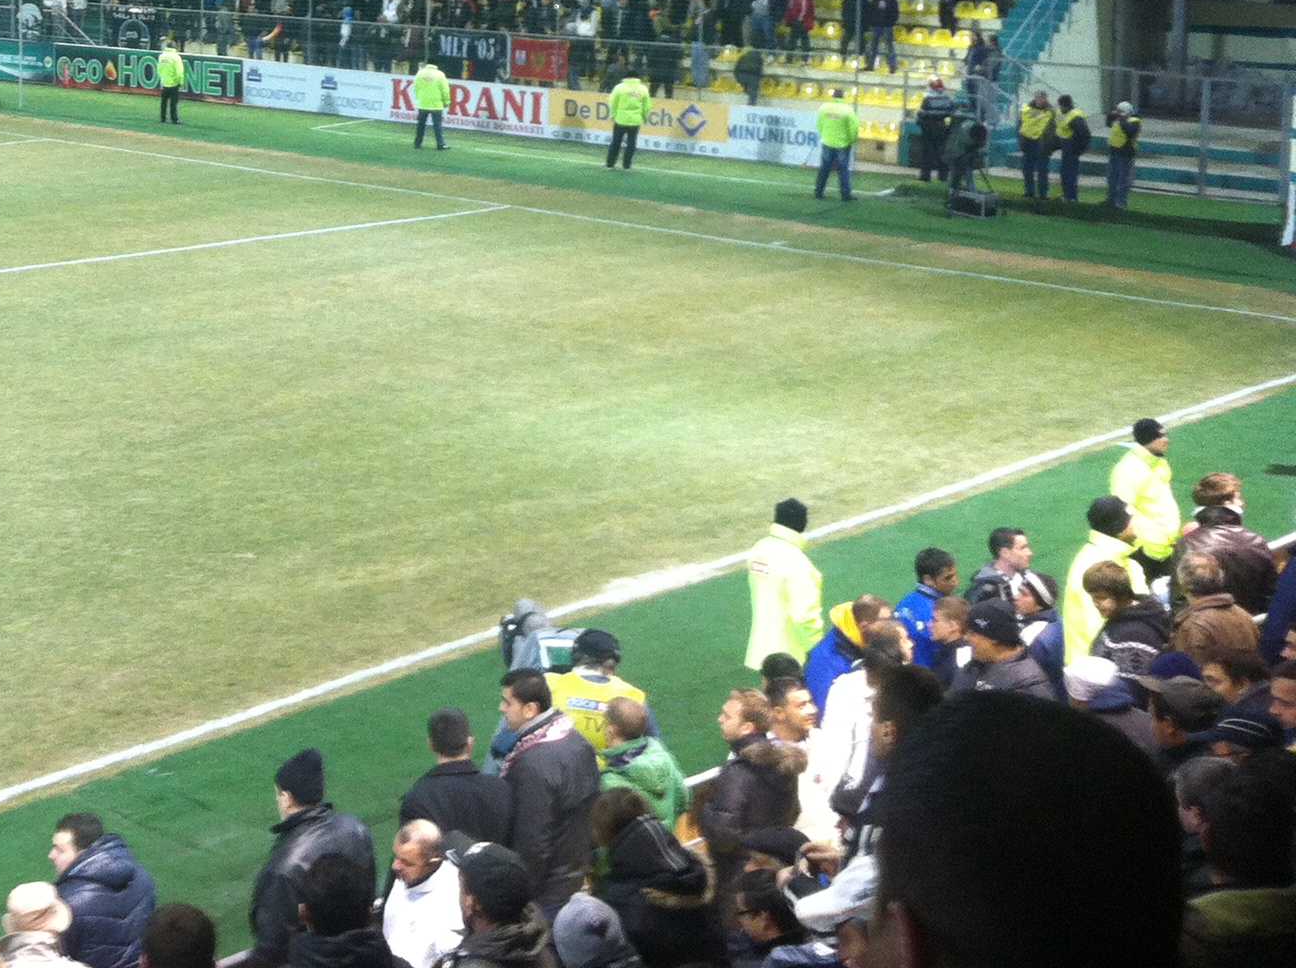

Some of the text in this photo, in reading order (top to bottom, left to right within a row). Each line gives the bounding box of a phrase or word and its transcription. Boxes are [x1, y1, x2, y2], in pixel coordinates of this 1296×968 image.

[118, 54, 241, 97] HONET
[391, 78, 544, 125] KRANI
[564, 99, 590, 119] De
